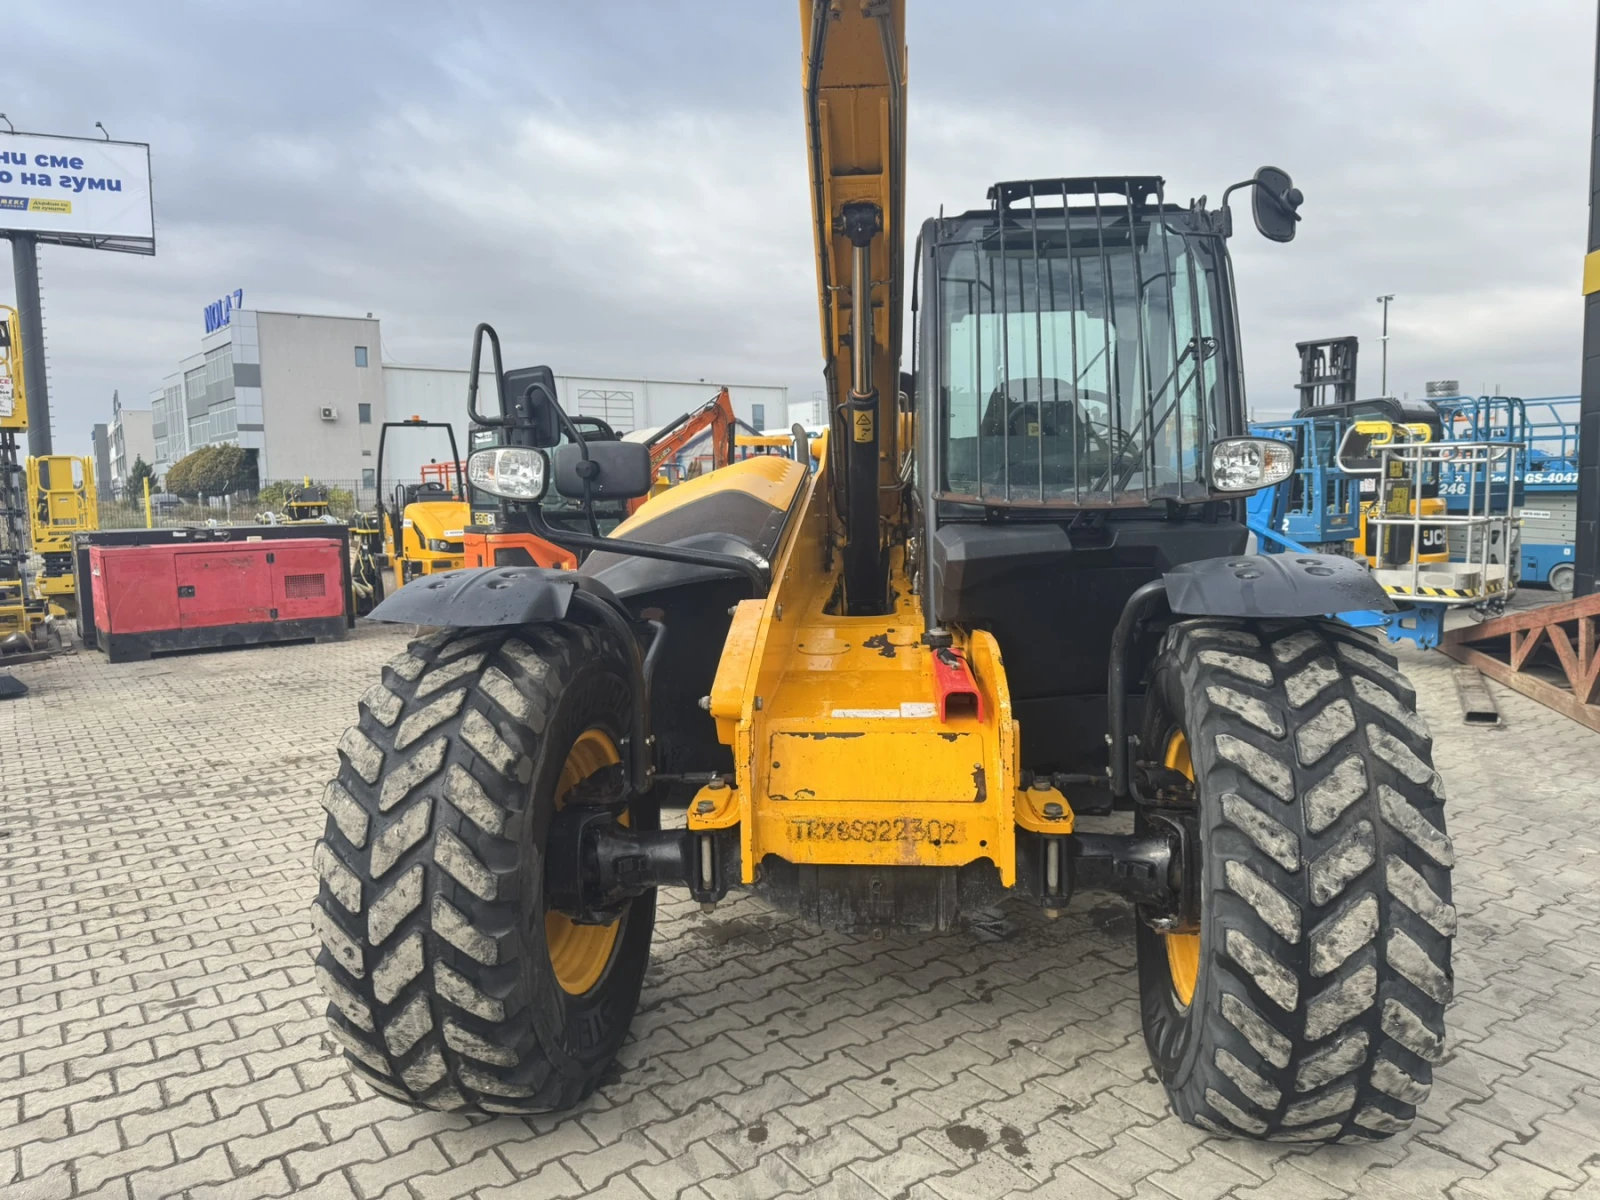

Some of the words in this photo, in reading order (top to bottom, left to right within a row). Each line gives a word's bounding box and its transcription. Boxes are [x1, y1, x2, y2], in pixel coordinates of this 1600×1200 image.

[34, 154, 84, 170] сме
[21, 172, 52, 187] на
[59, 175, 122, 193] гуми
[1524, 472, 1579, 483] GS-4047
